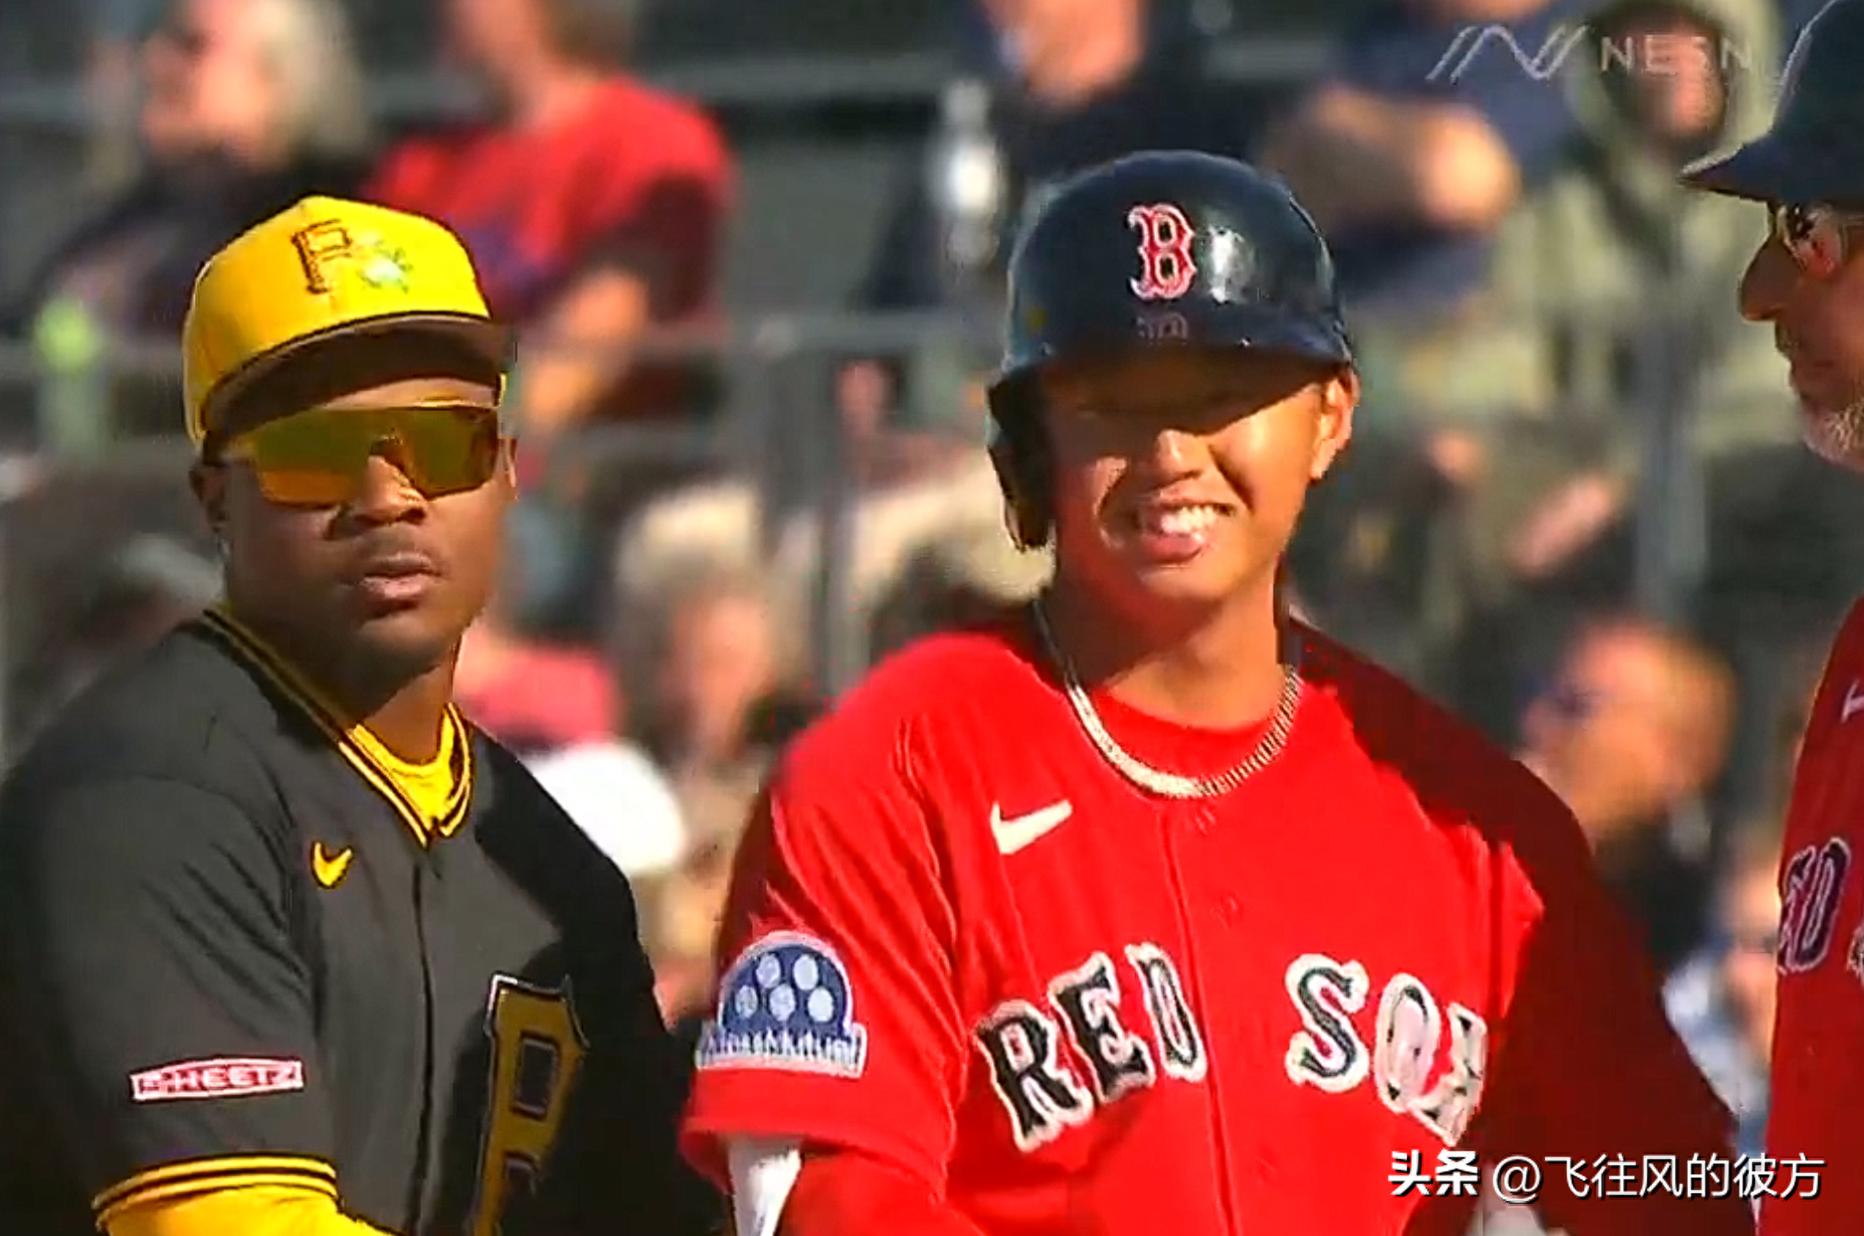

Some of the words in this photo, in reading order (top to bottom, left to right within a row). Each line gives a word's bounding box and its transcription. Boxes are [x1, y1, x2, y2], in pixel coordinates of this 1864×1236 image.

[291, 218, 352, 293] P
[1127, 203, 1197, 298] B
[138, 1063, 296, 1094] SHEETZ
[973, 942, 1208, 1152] RED
